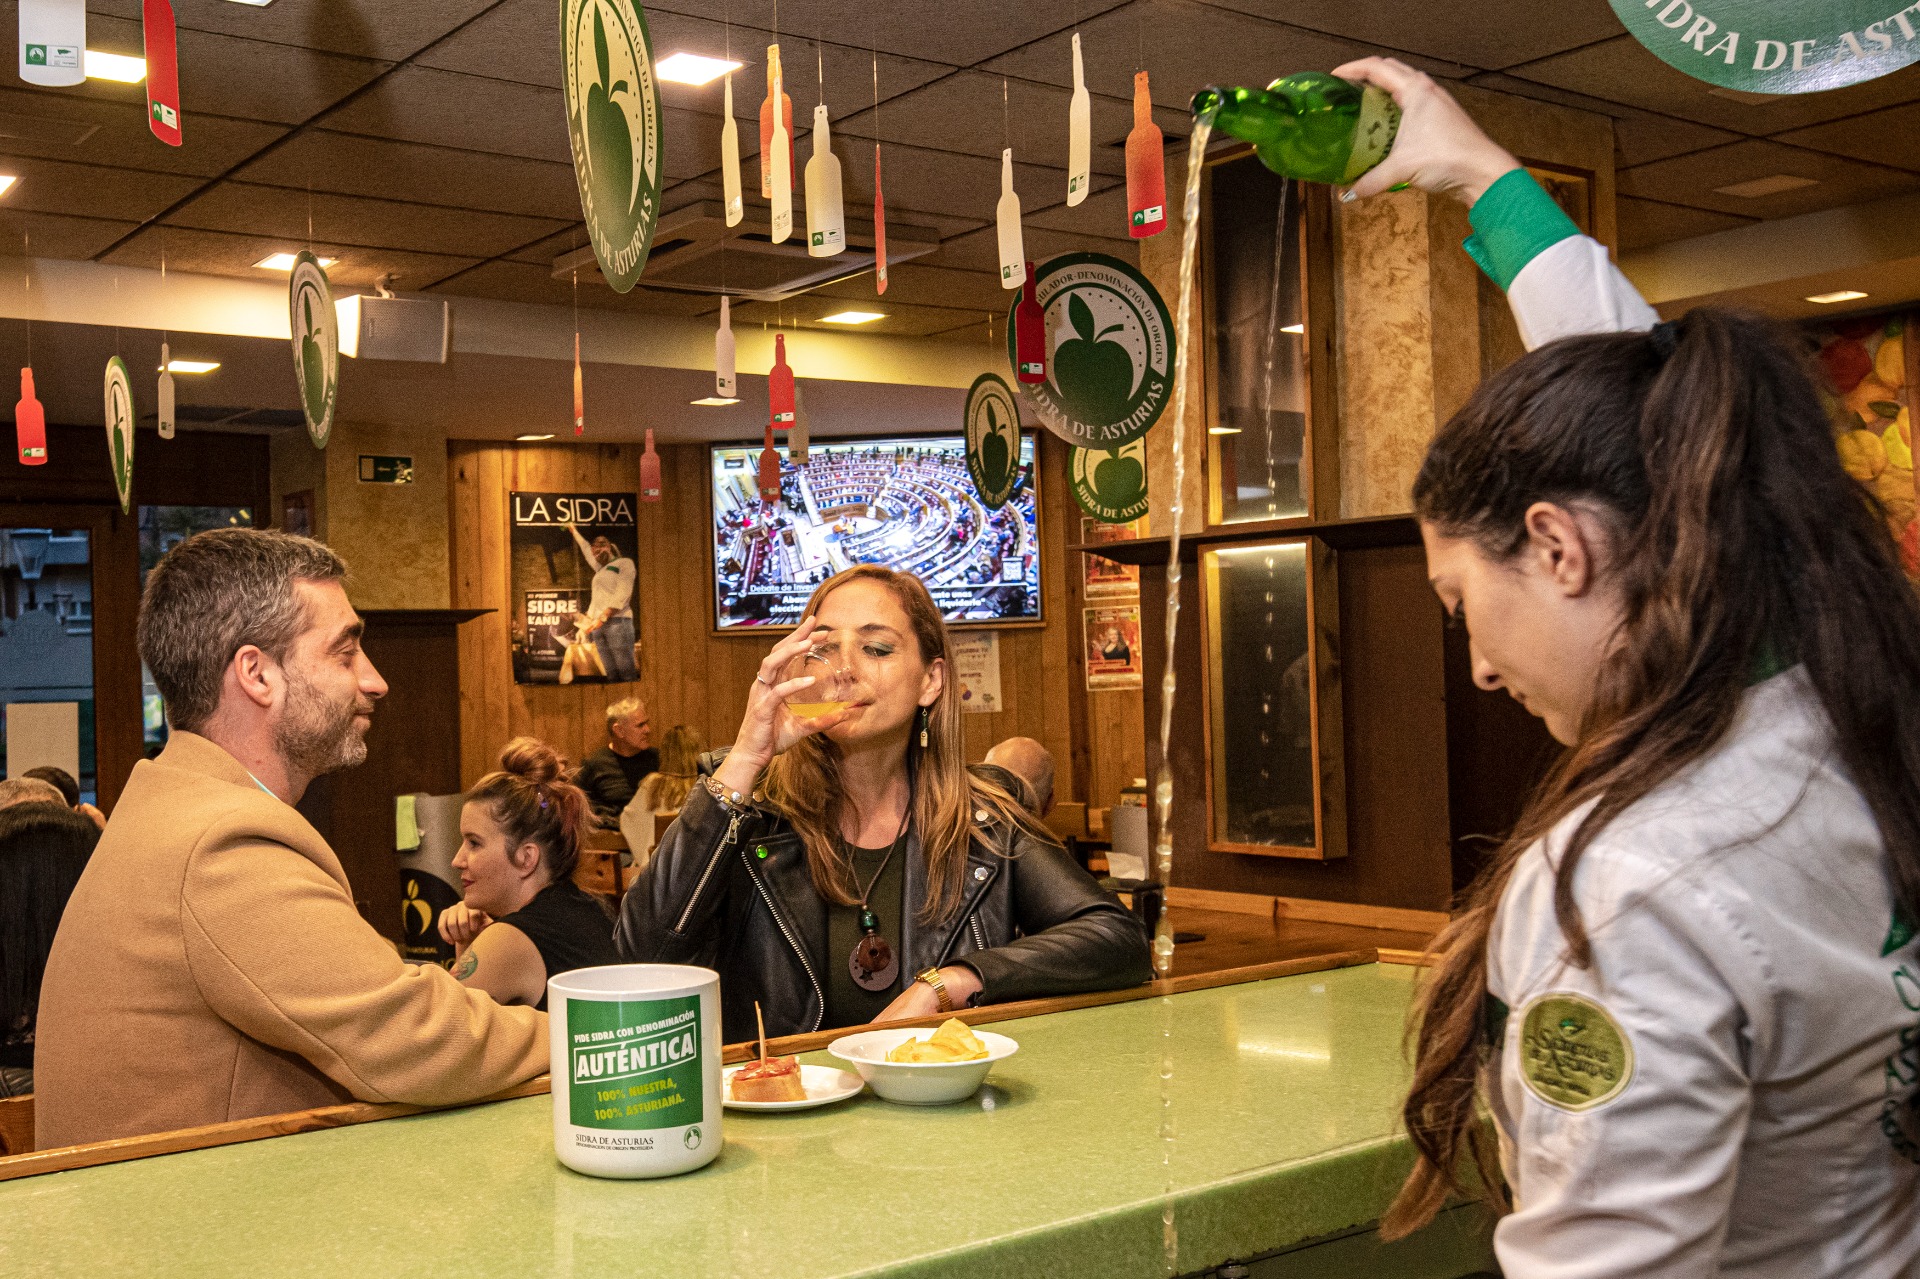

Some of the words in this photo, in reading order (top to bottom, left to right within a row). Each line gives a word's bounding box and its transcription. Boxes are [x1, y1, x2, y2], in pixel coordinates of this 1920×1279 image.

[1752, 39, 1817, 72] DE
[645, 99, 654, 168] ORIGEN
[574, 132, 598, 241] SIDRA
[600, 229, 612, 269] DE
[614, 191, 652, 276] ASTURIAS
[1145, 309, 1156, 323] DE
[1152, 324, 1162, 365] ORIGEN
[1072, 420, 1095, 440] DE
[1100, 380, 1164, 441] ASTURIAS
[515, 496, 551, 522] LA
[555, 497, 634, 523] SIDRA
[1077, 484, 1101, 514] SIDRA
[1103, 507, 1118, 518] DE
[749, 583, 780, 593] Debate
[780, 583, 793, 592] de
[527, 599, 578, 614] SIDRE
[574, 1033, 590, 1043] PIDE
[591, 1030, 615, 1042] SIDRA
[616, 1027, 634, 1038] CON
[635, 1010, 695, 1035] DENOMINACIÓN
[576, 1032, 695, 1078] AUTÉNTICA
[597, 1089, 626, 1102] 100%
[628, 1077, 677, 1098] NUESTRA,
[594, 1107, 623, 1120] 100%
[626, 1093, 685, 1117] ASTURIANA.
[575, 1133, 598, 1144] SIDRA
[599, 1136, 609, 1145] DE
[611, 1136, 654, 1146] ASTURIAS
